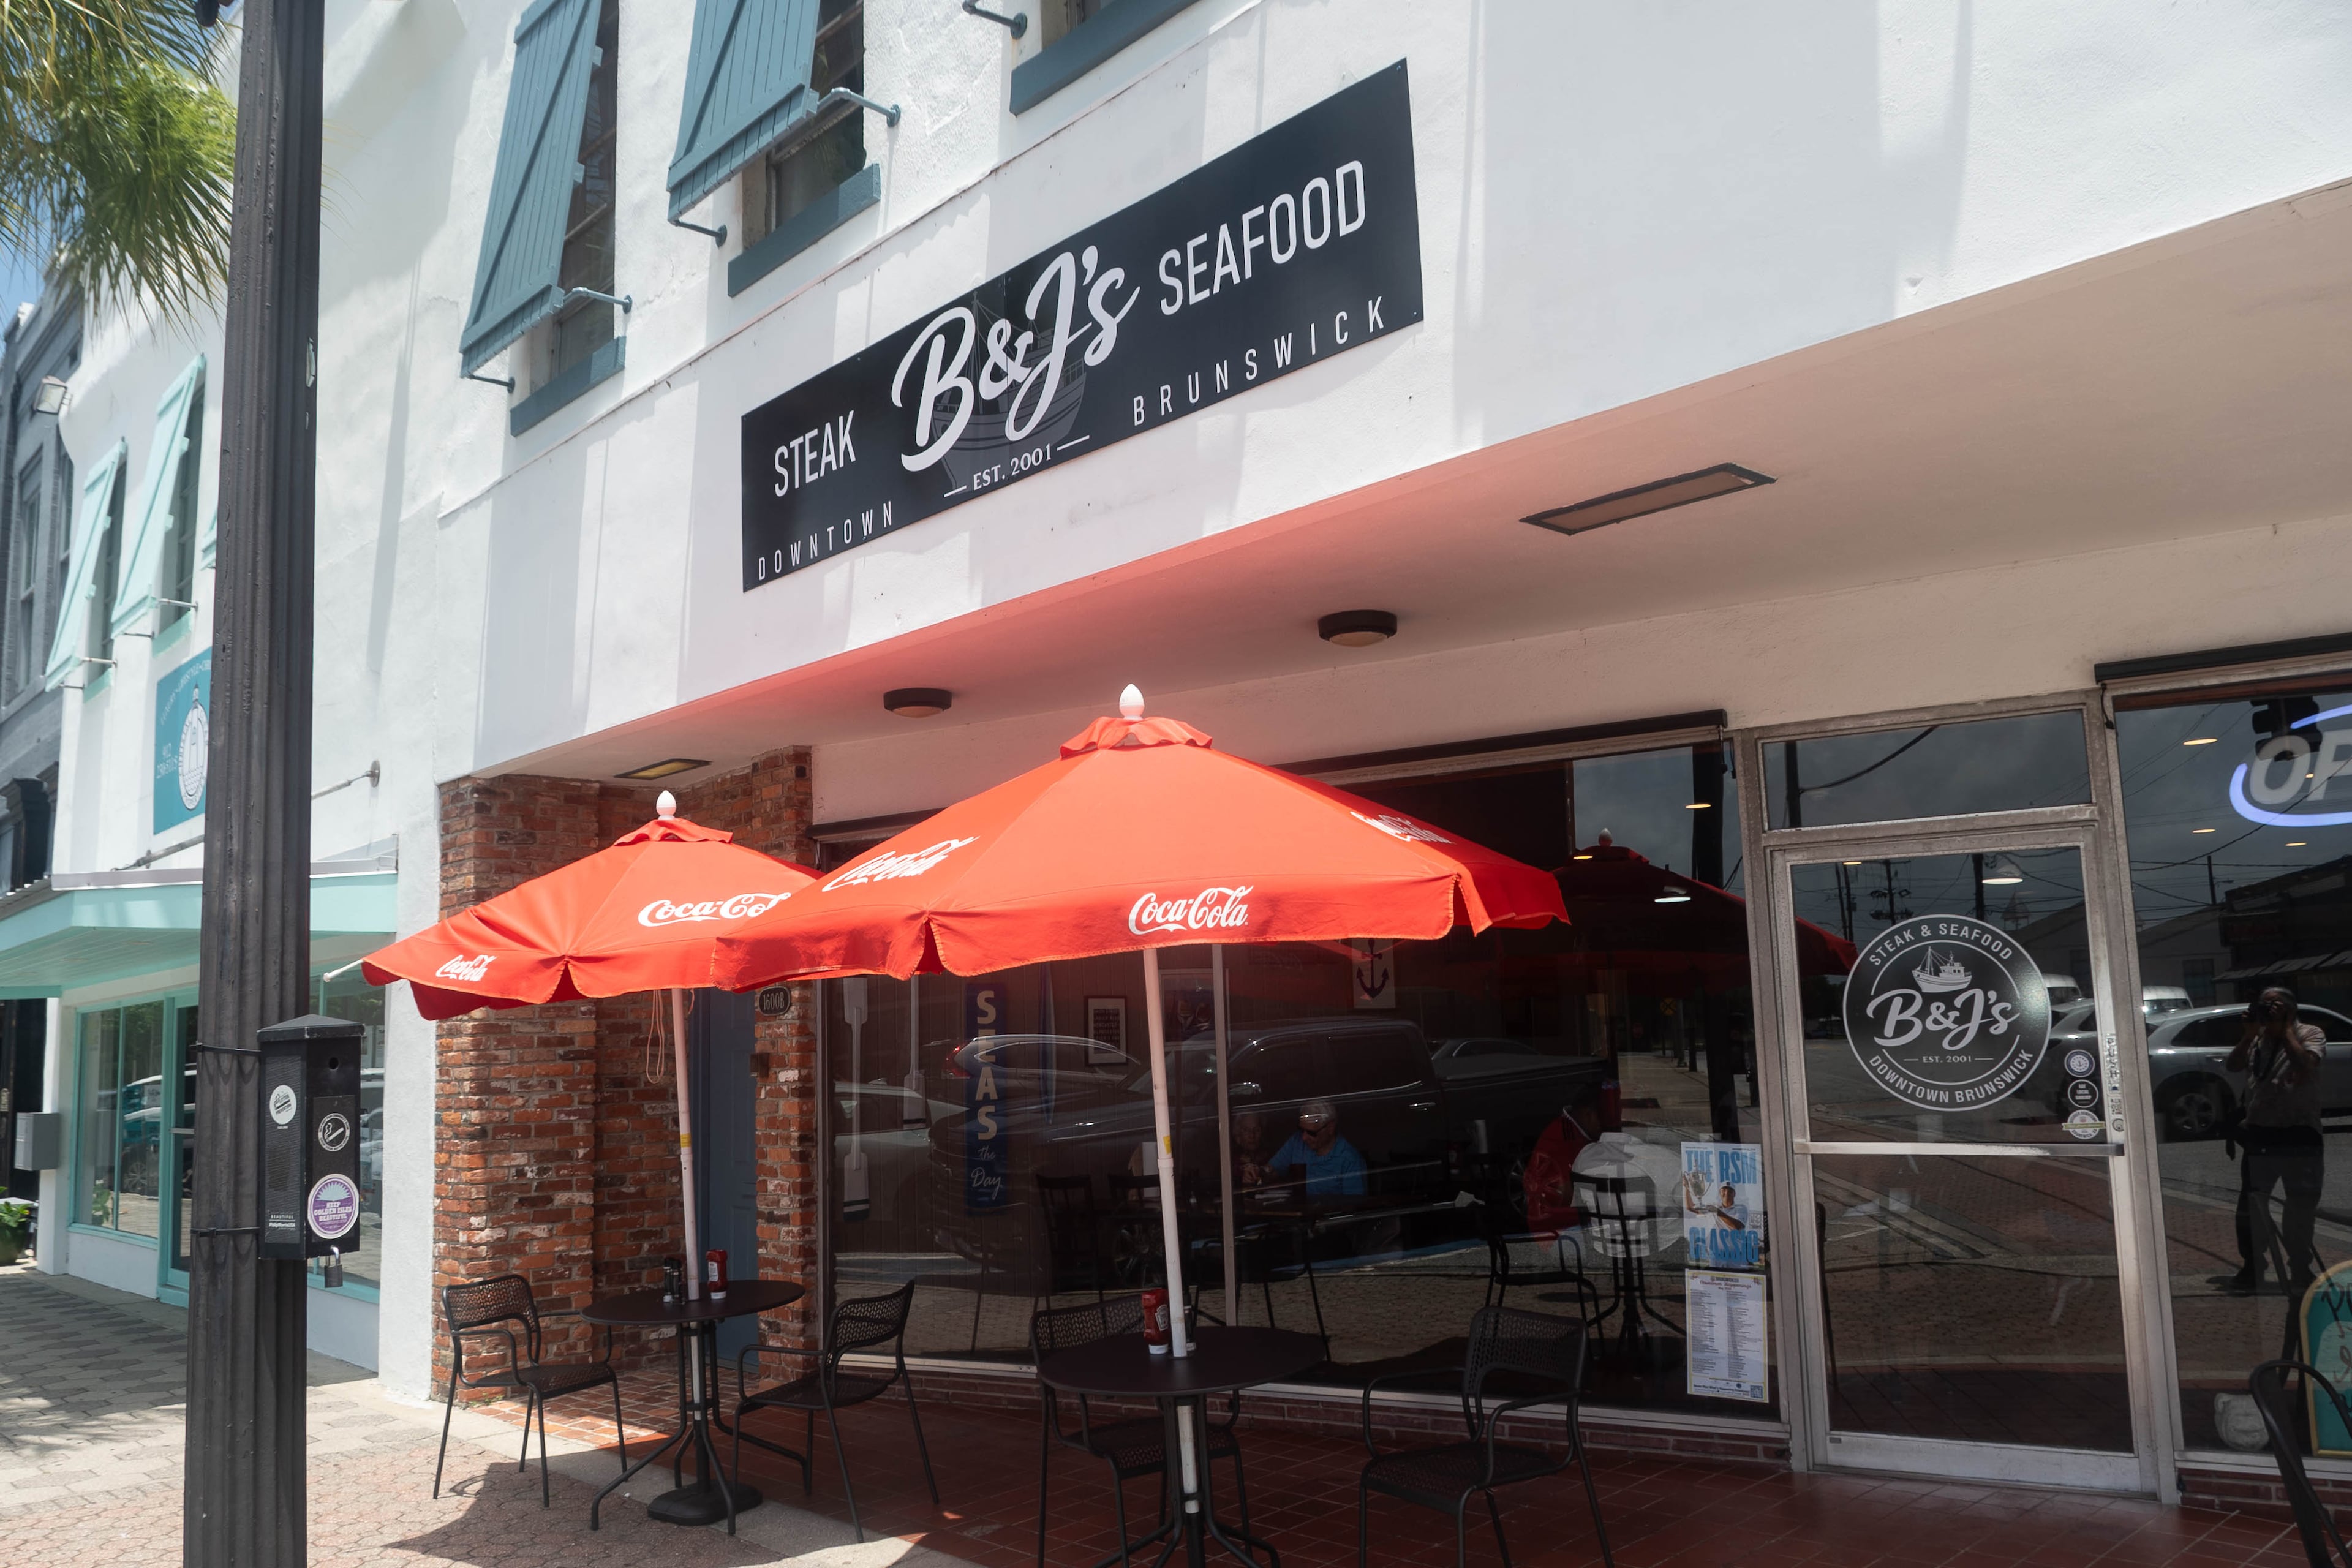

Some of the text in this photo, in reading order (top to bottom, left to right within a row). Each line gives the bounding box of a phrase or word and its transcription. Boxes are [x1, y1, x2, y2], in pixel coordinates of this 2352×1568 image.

[1159, 160, 1366, 315] SEAFOOD
[891, 245, 1140, 472] B&J's
[1133, 296, 1384, 426] BRUNSWICK
[774, 410, 856, 497] STEAK
[973, 446, 1052, 491] EST. 2001
[758, 500, 892, 581] DOWNTOWN
[638, 892, 792, 927] Coca-Col
[1128, 885, 1254, 935] Coca-Cola
[1869, 923, 2013, 966] STEAK & SEAFOOD
[763, 992, 785, 1010] 1600B
[1866, 988, 2021, 1051] B&J's
[975, 990, 998, 1141] SEAS
[1869, 1055, 1949, 1103] DOWNTOWN
[1954, 1049, 2034, 1103] BRUNSWICK
[1686, 1150, 1757, 1184] THE RSM
[319, 1213, 347, 1222] BEAUTIFUL
[1689, 1227, 1758, 1262] CLASSIC
